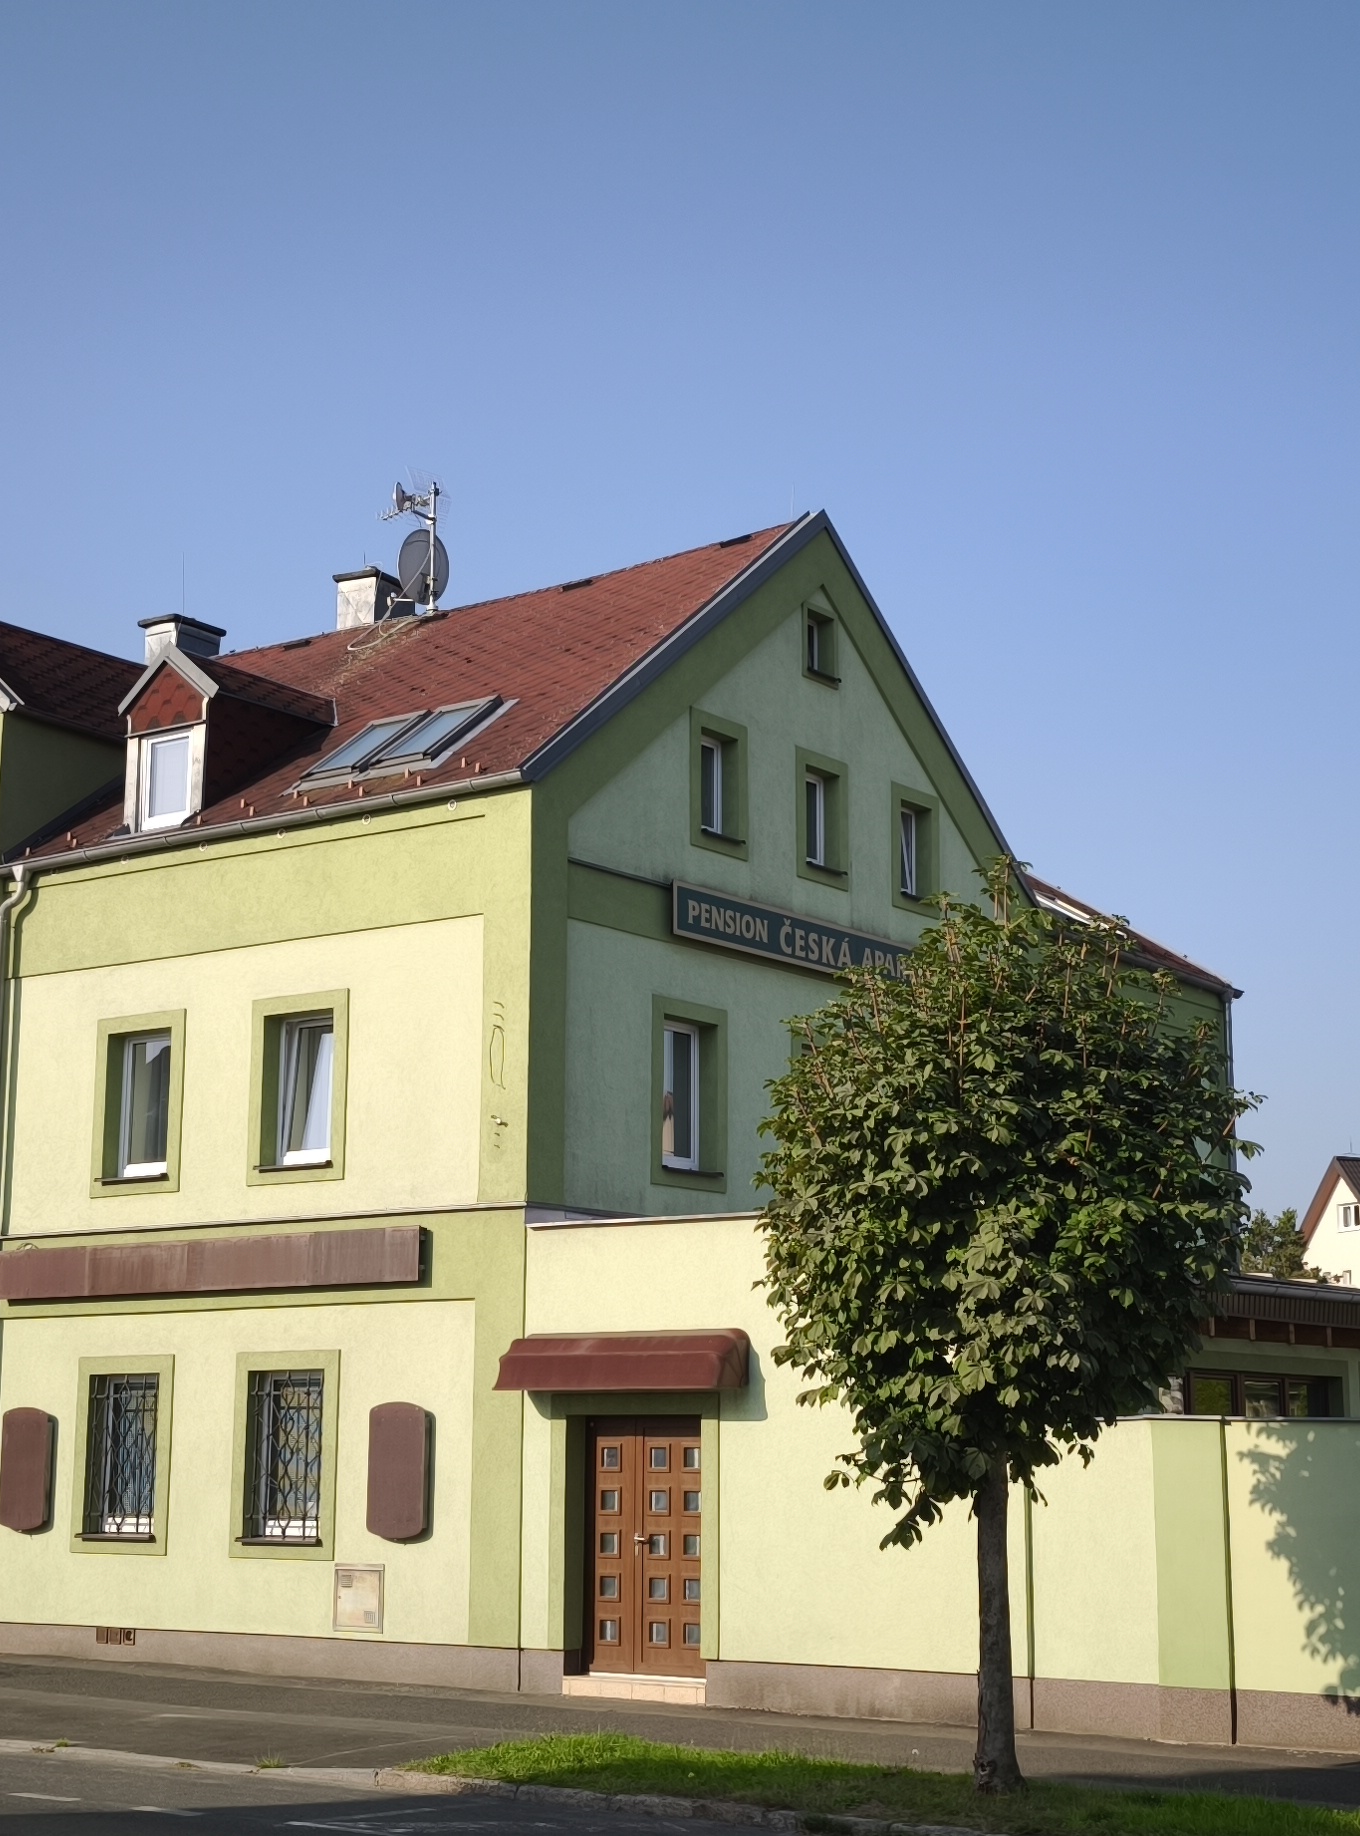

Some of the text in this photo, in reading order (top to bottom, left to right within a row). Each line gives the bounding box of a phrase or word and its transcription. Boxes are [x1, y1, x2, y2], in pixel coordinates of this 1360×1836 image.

[687, 899, 907, 978] PENSION ČESKÁ APAR
